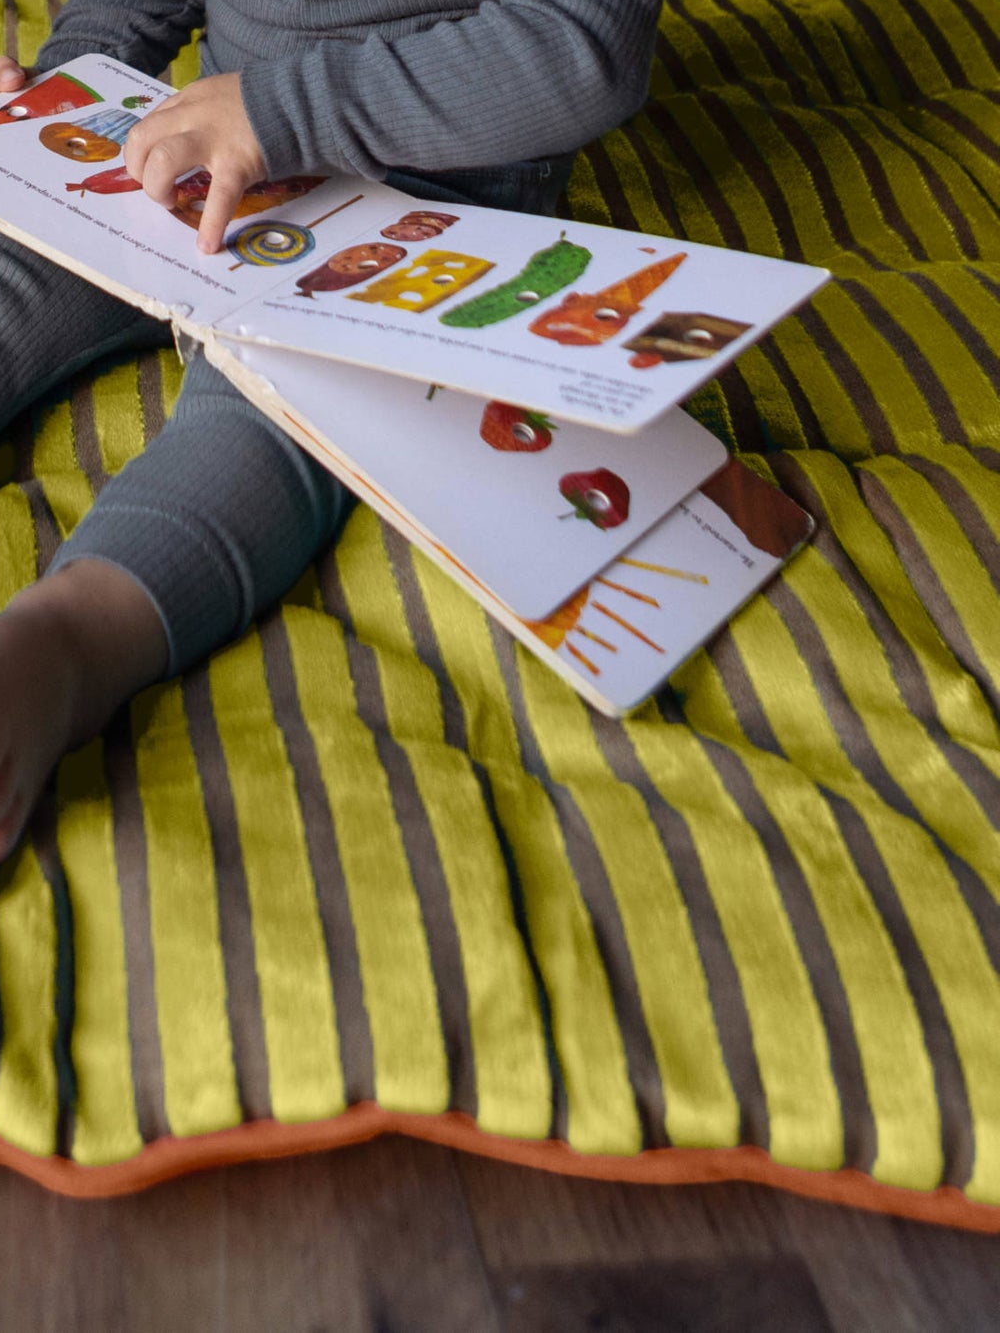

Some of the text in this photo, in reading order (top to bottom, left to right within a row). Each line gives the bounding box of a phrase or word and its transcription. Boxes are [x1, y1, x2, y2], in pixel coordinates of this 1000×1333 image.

[689, 512, 703, 524] to
[699, 520, 741, 555] started
[736, 553, 755, 569] He
